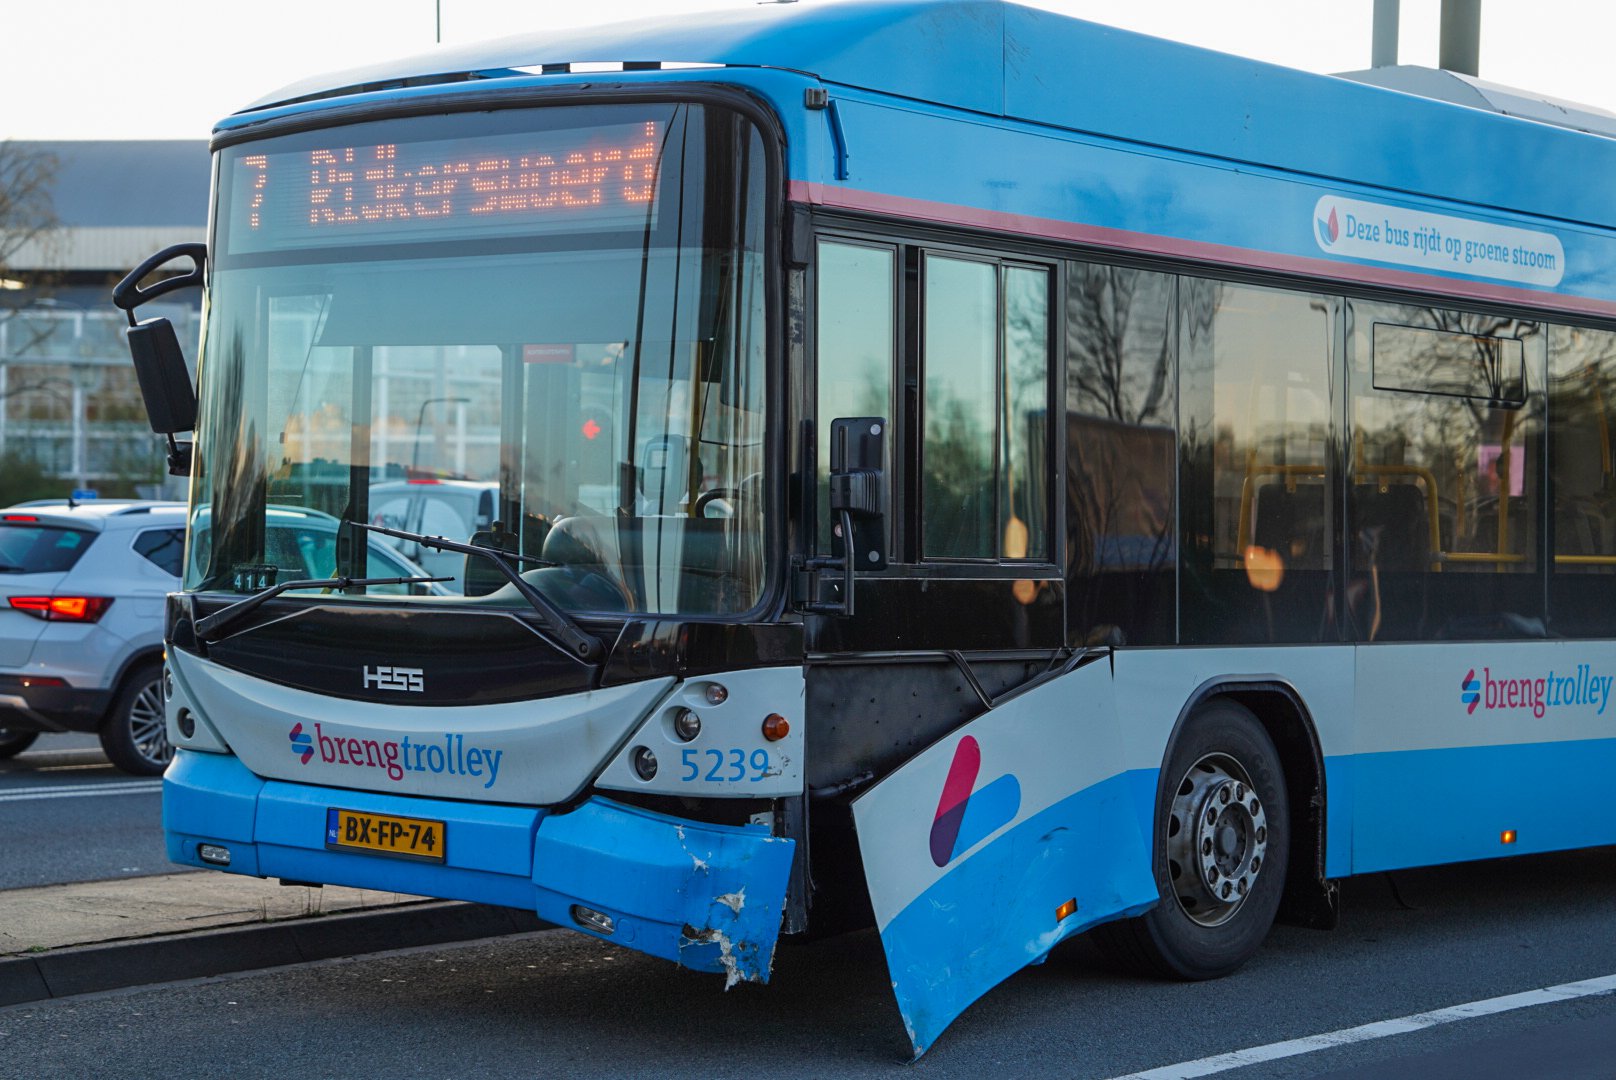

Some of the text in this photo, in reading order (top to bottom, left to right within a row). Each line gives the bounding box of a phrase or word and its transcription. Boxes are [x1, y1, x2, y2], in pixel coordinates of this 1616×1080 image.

[245, 154, 267, 228] 7
[1345, 214, 1556, 270] Deze bus rijdt op groene stroom
[363, 665, 424, 692] HESS
[1484, 664, 1613, 719] brengtrolley
[314, 723, 502, 789] brengtrolley
[681, 748, 769, 782] 5239
[328, 816, 435, 852] NL BX-FP-74
